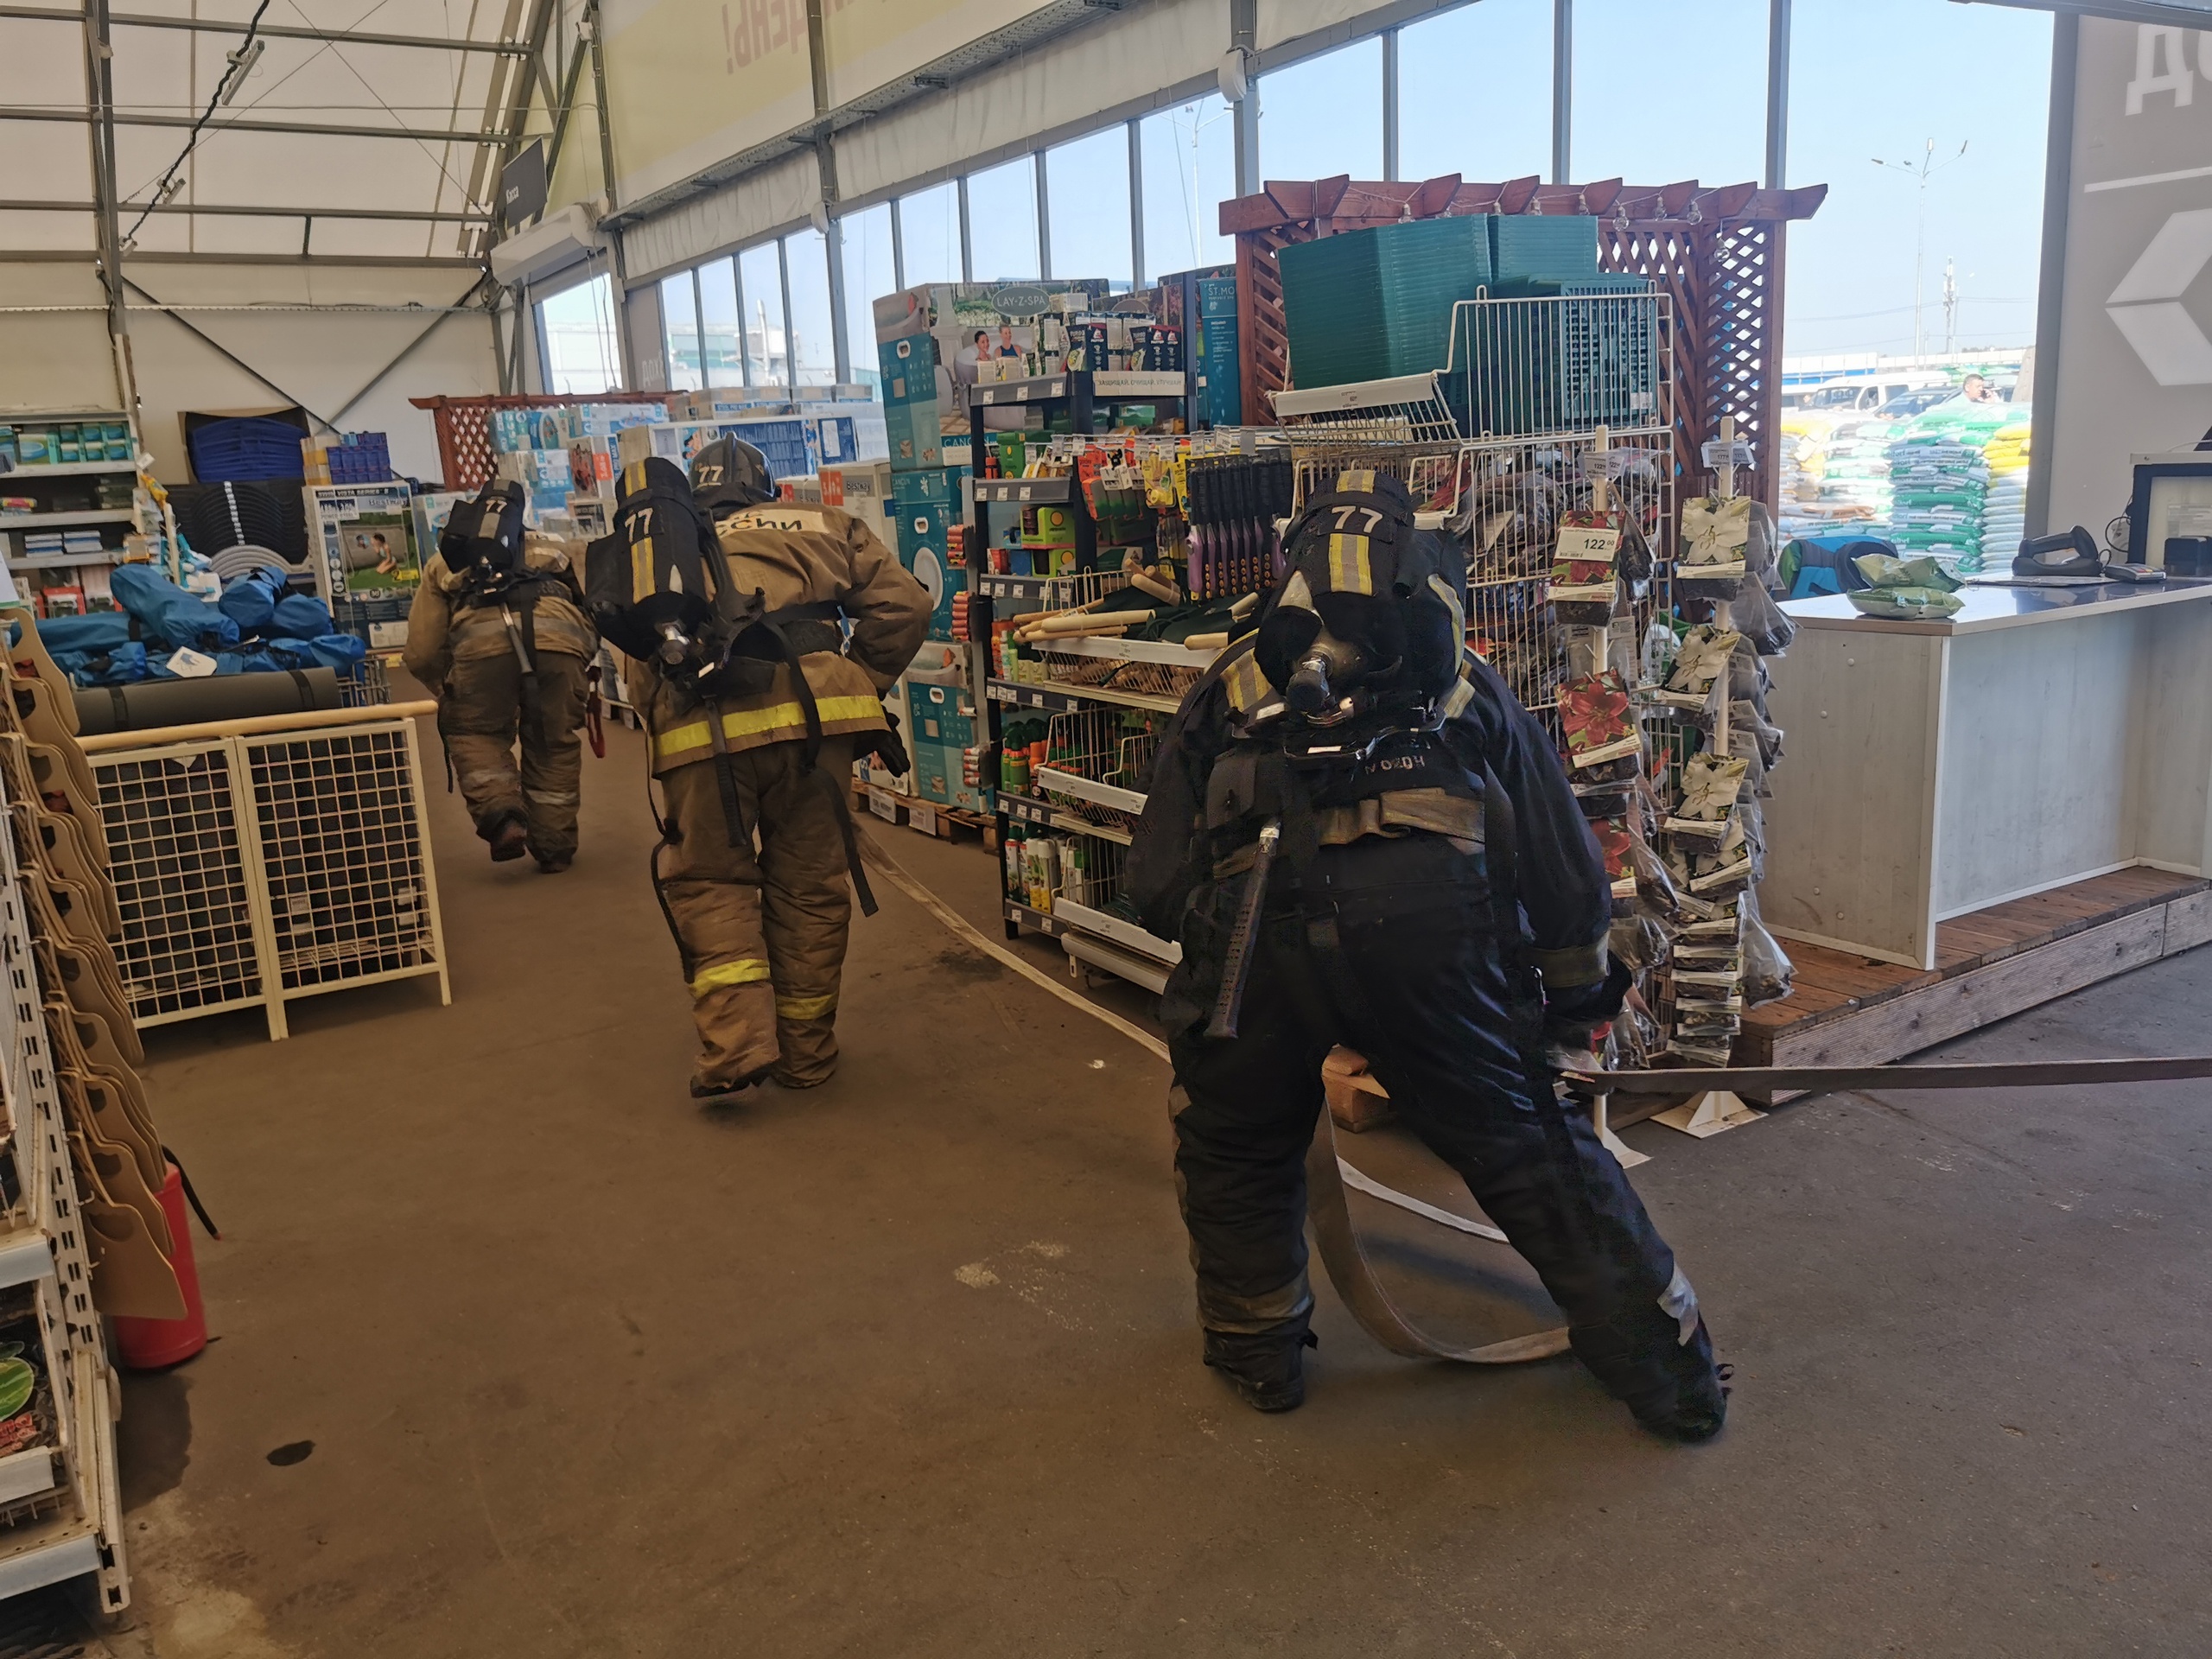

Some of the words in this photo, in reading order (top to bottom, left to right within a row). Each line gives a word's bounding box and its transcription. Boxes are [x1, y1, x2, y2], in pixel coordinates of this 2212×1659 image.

[944, 436, 990, 447] CANCN
[697, 466, 724, 482] 77
[486, 499, 508, 513] 77
[625, 507, 654, 543] 77
[716, 518, 802, 535] СИИ
[1332, 505, 1383, 533] 77
[1584, 538, 1605, 550] 122
